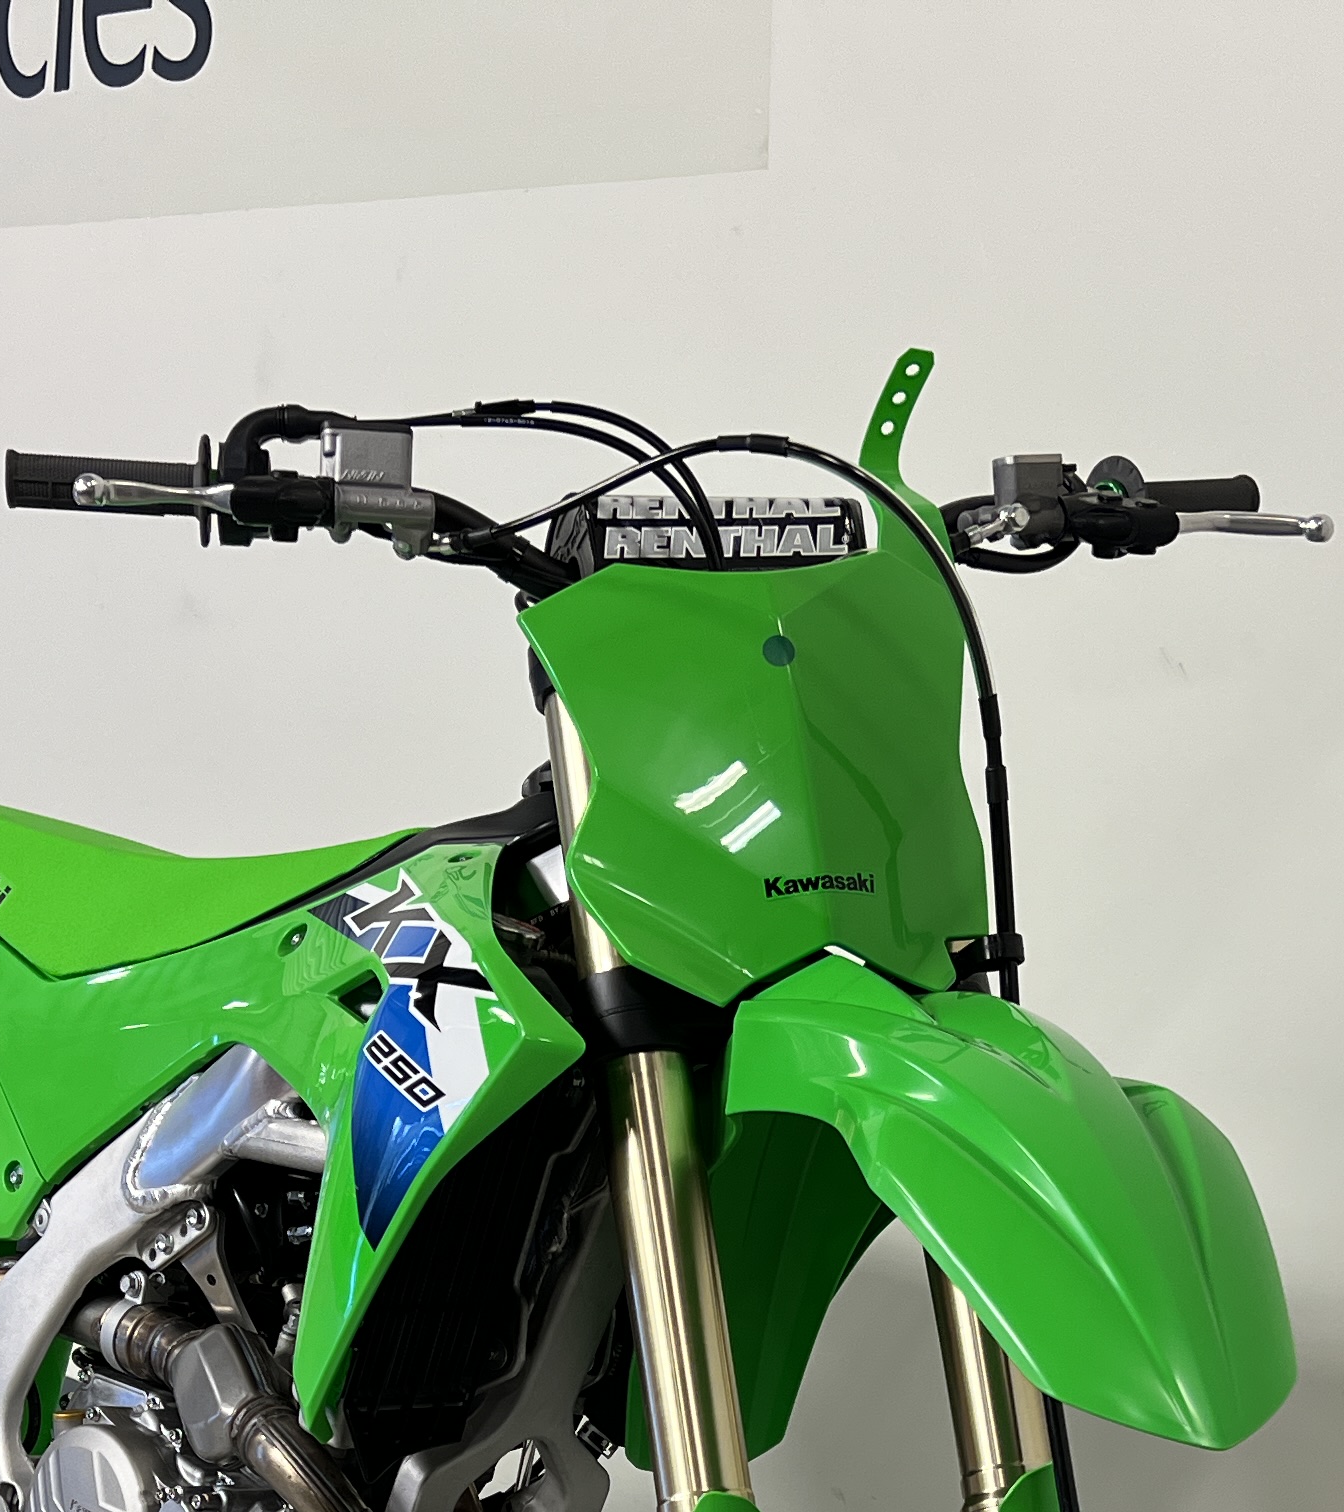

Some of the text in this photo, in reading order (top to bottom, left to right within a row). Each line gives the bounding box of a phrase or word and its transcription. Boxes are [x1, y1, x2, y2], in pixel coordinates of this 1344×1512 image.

[603, 524, 849, 559] RENTHAL
[763, 872, 875, 898] Kawasaki
[364, 1031, 447, 1110] 250
